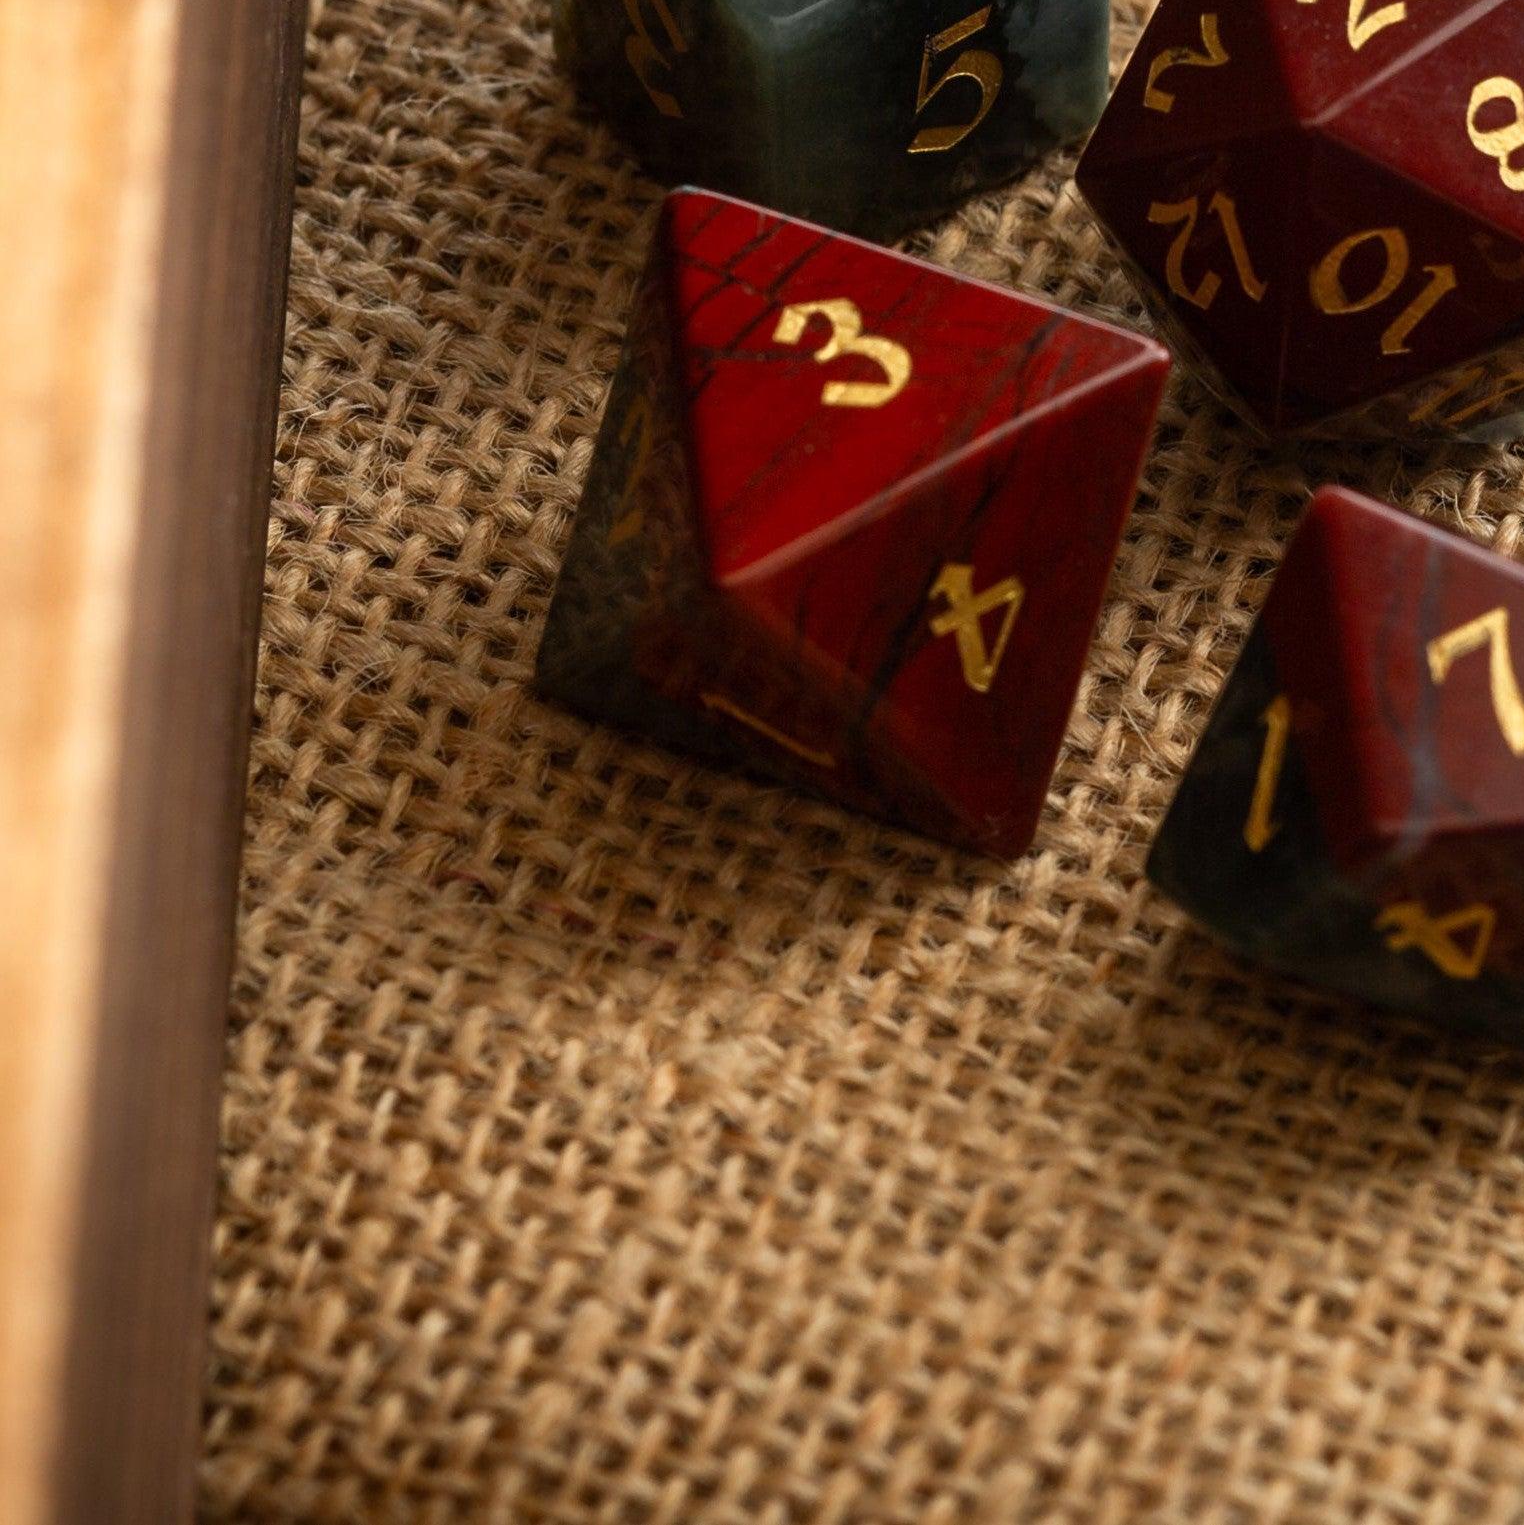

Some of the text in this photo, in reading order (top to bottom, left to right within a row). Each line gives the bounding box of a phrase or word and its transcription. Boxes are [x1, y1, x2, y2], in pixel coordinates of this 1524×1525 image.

[907, 4, 1003, 153] 5
[772, 297, 913, 407] 3
[1310, 227, 1457, 356] 10
[928, 564, 1025, 693] 4
[1243, 693, 1290, 853] 1
[1375, 901, 1496, 979] 4
